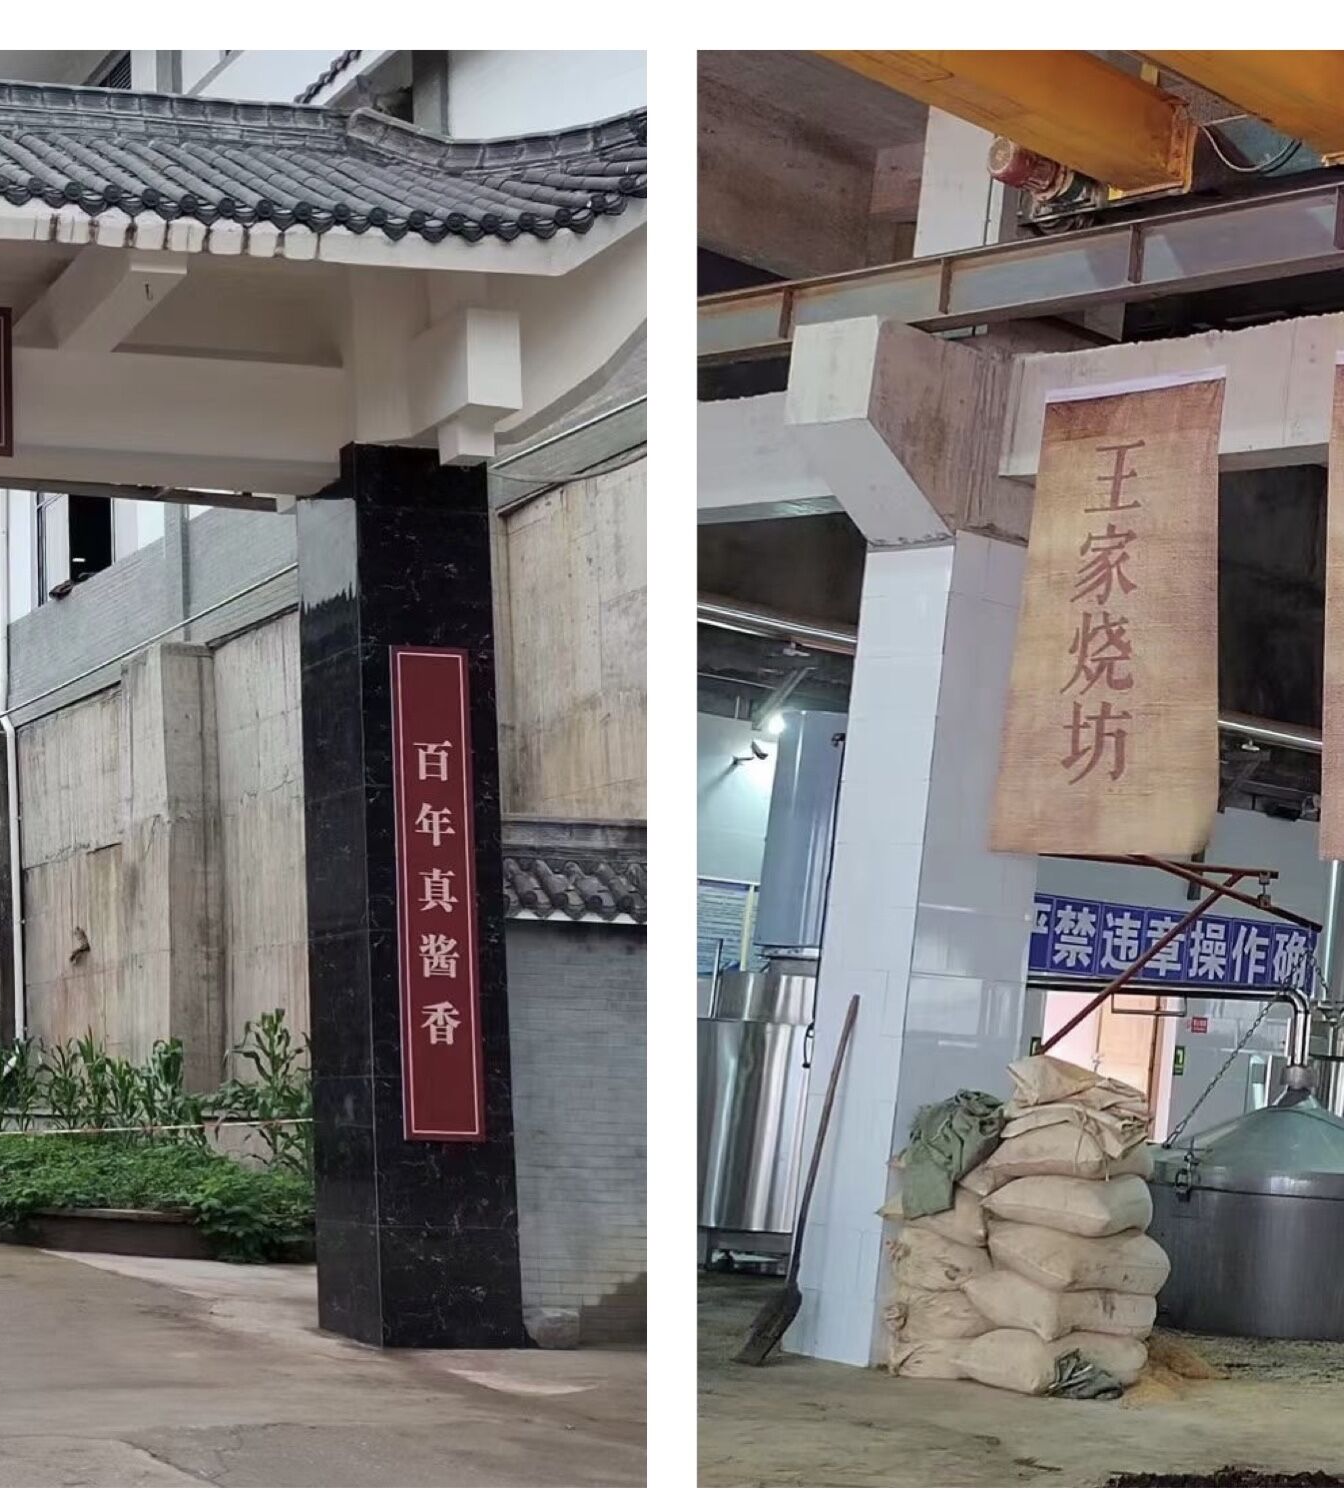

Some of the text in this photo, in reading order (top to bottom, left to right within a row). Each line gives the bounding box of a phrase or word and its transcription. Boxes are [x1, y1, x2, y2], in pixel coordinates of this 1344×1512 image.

[1059, 439, 1146, 785] 王家烧坊
[412, 740, 461, 1046] 百年真酱香
